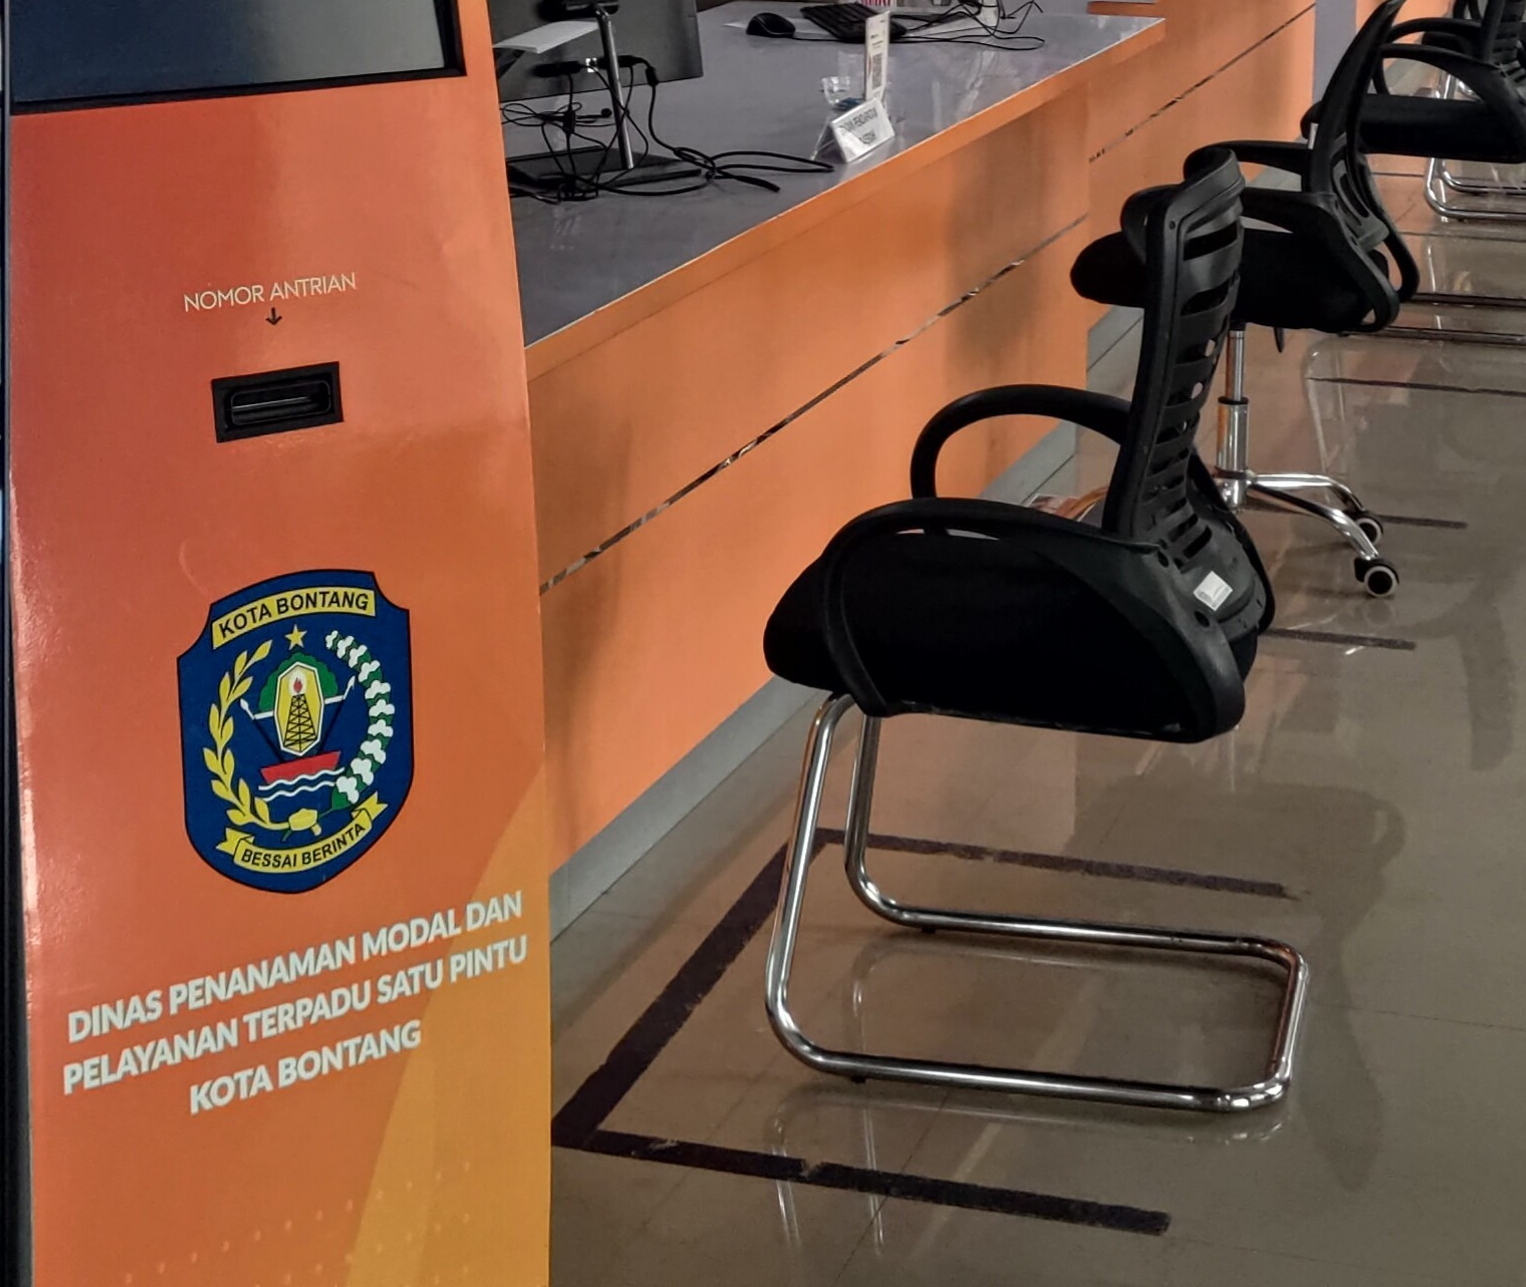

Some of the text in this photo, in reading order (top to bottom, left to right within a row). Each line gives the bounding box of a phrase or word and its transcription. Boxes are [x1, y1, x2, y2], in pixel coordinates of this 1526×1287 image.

[184, 272, 356, 312] NOMOR ANTRIAN
[219, 590, 369, 638] KOTA BONTANG
[241, 823, 365, 868] BESSAI BERINTA
[68, 891, 523, 1043] DINAS PENANAMAN MODAL DAN
[63, 935, 528, 1095] PELAYANAN TERPADU SATU PINTU
[189, 1019, 422, 1115] KOTA BONTANG
